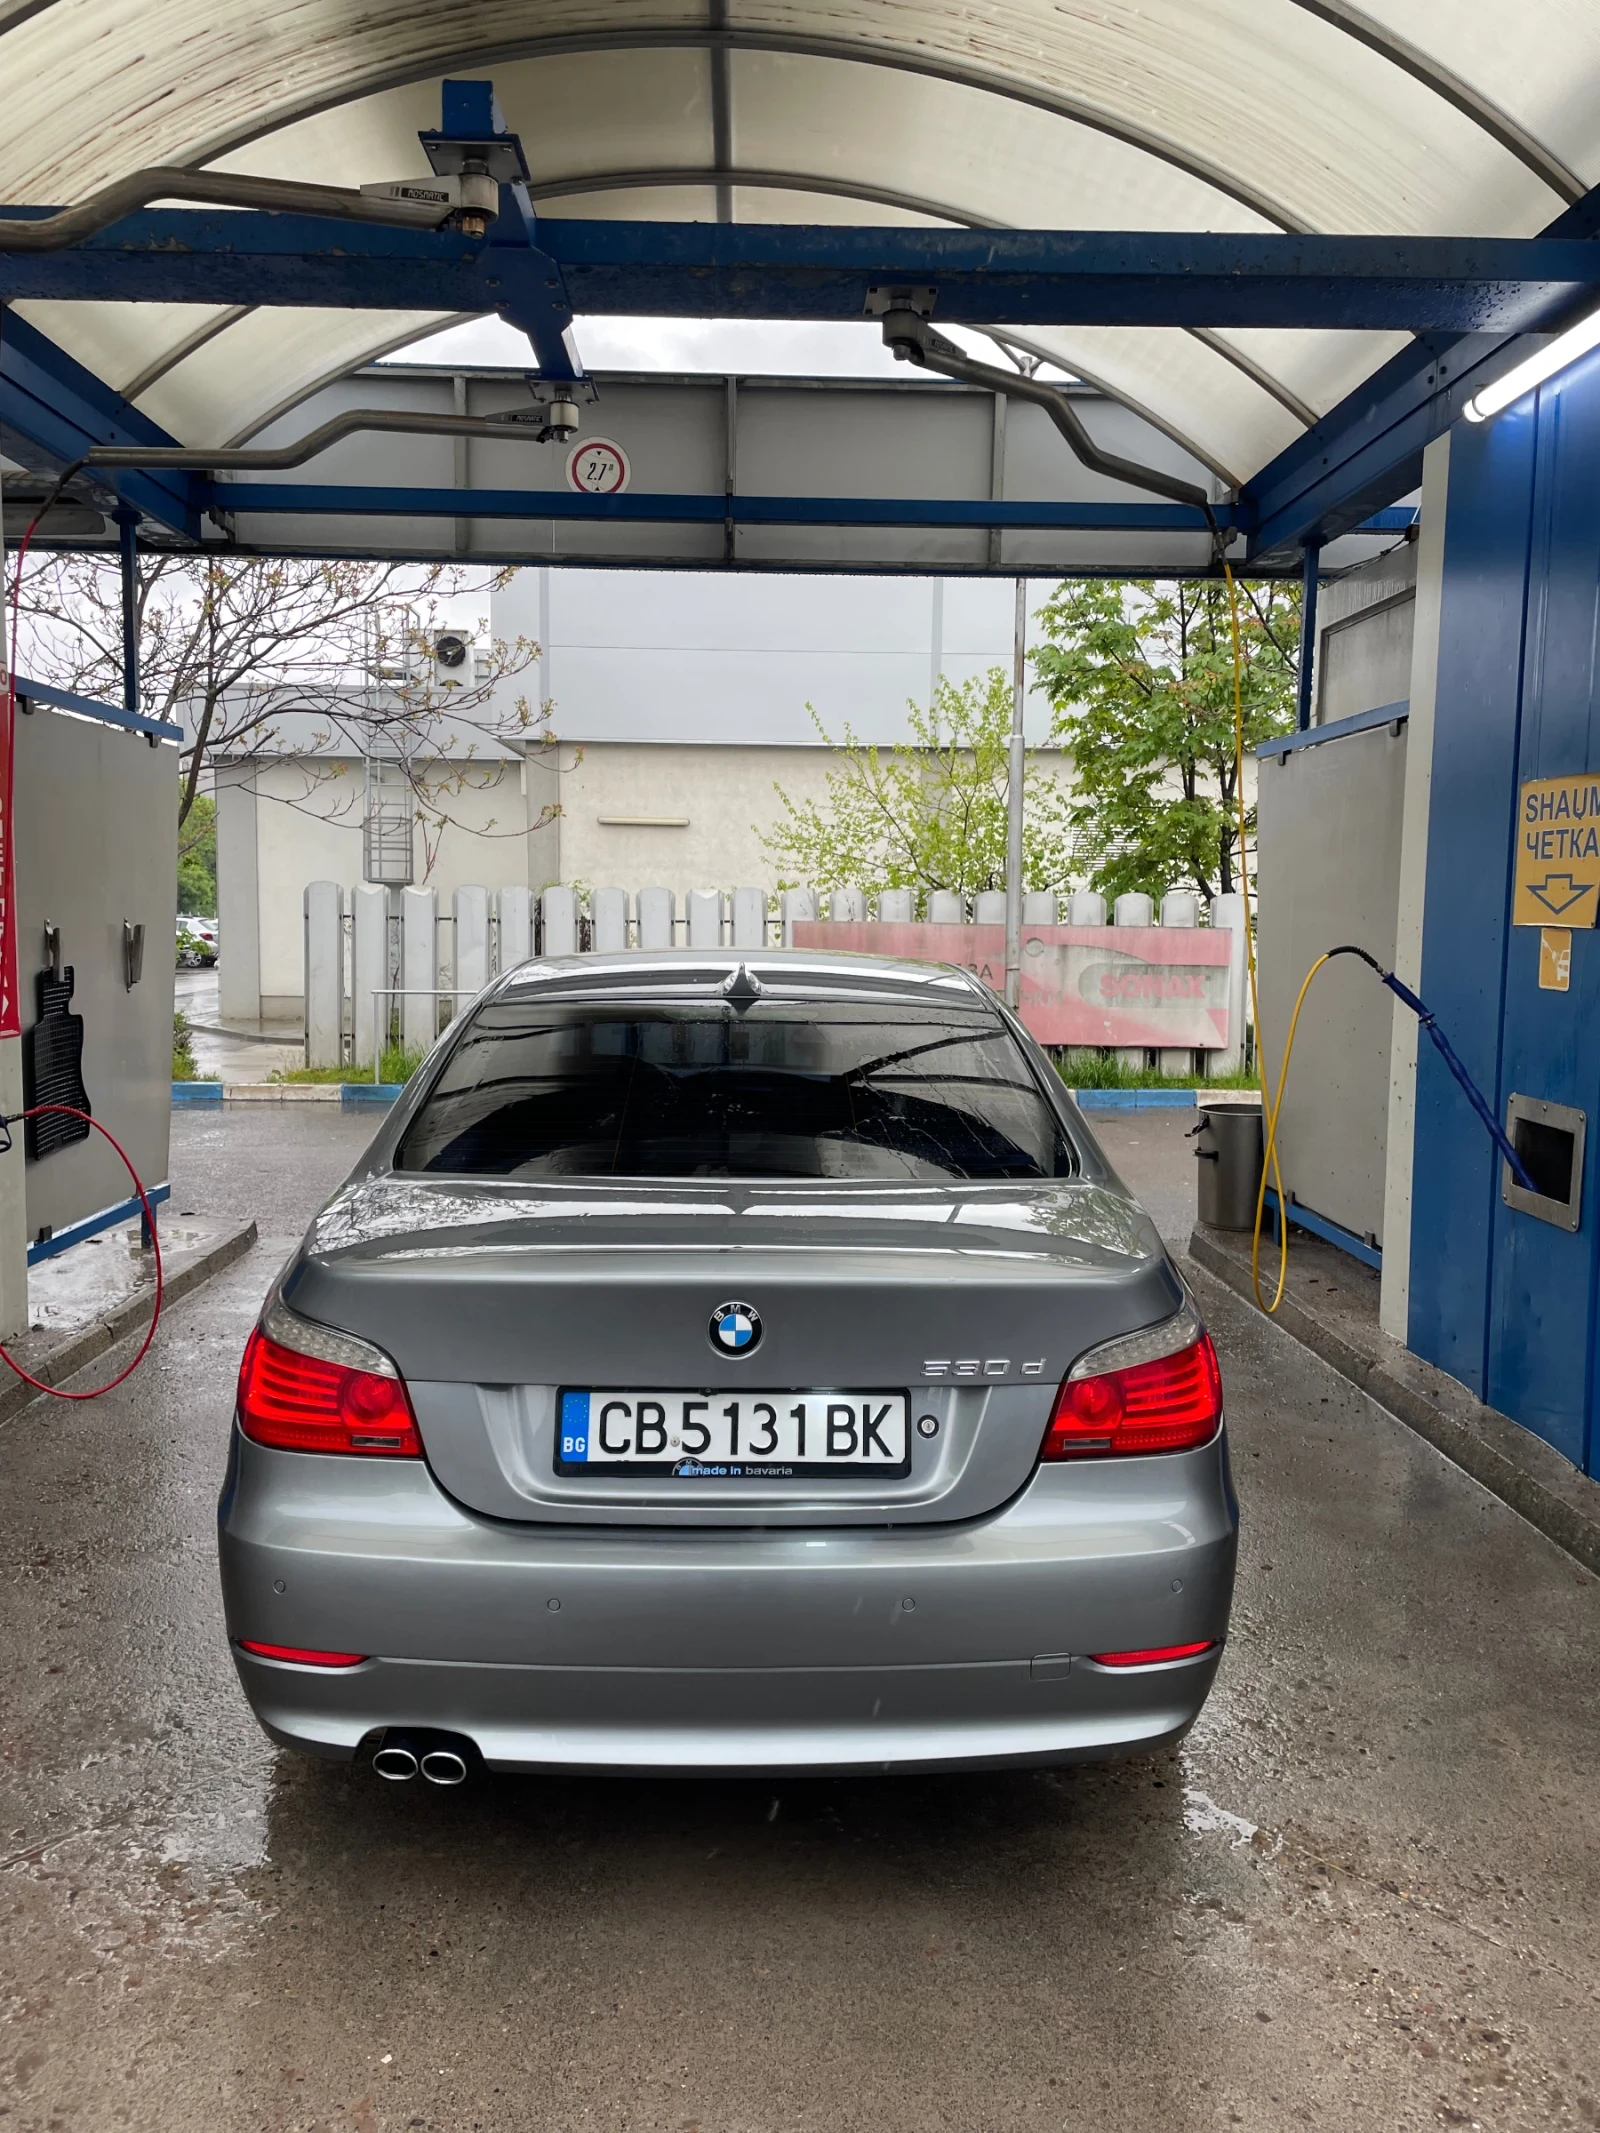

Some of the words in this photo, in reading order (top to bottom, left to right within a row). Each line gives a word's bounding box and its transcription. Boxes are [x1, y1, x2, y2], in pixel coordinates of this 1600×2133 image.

[1526, 827, 1600, 860] ЧЕТКА
[714, 1304, 758, 1322] BMW
[920, 1360, 1011, 1376] 530
[1020, 1358, 1047, 1375] d
[563, 1436, 586, 1453] BG
[692, 1466, 727, 1475] made
[730, 1466, 741, 1475] in
[745, 1466, 793, 1475] bavaria
